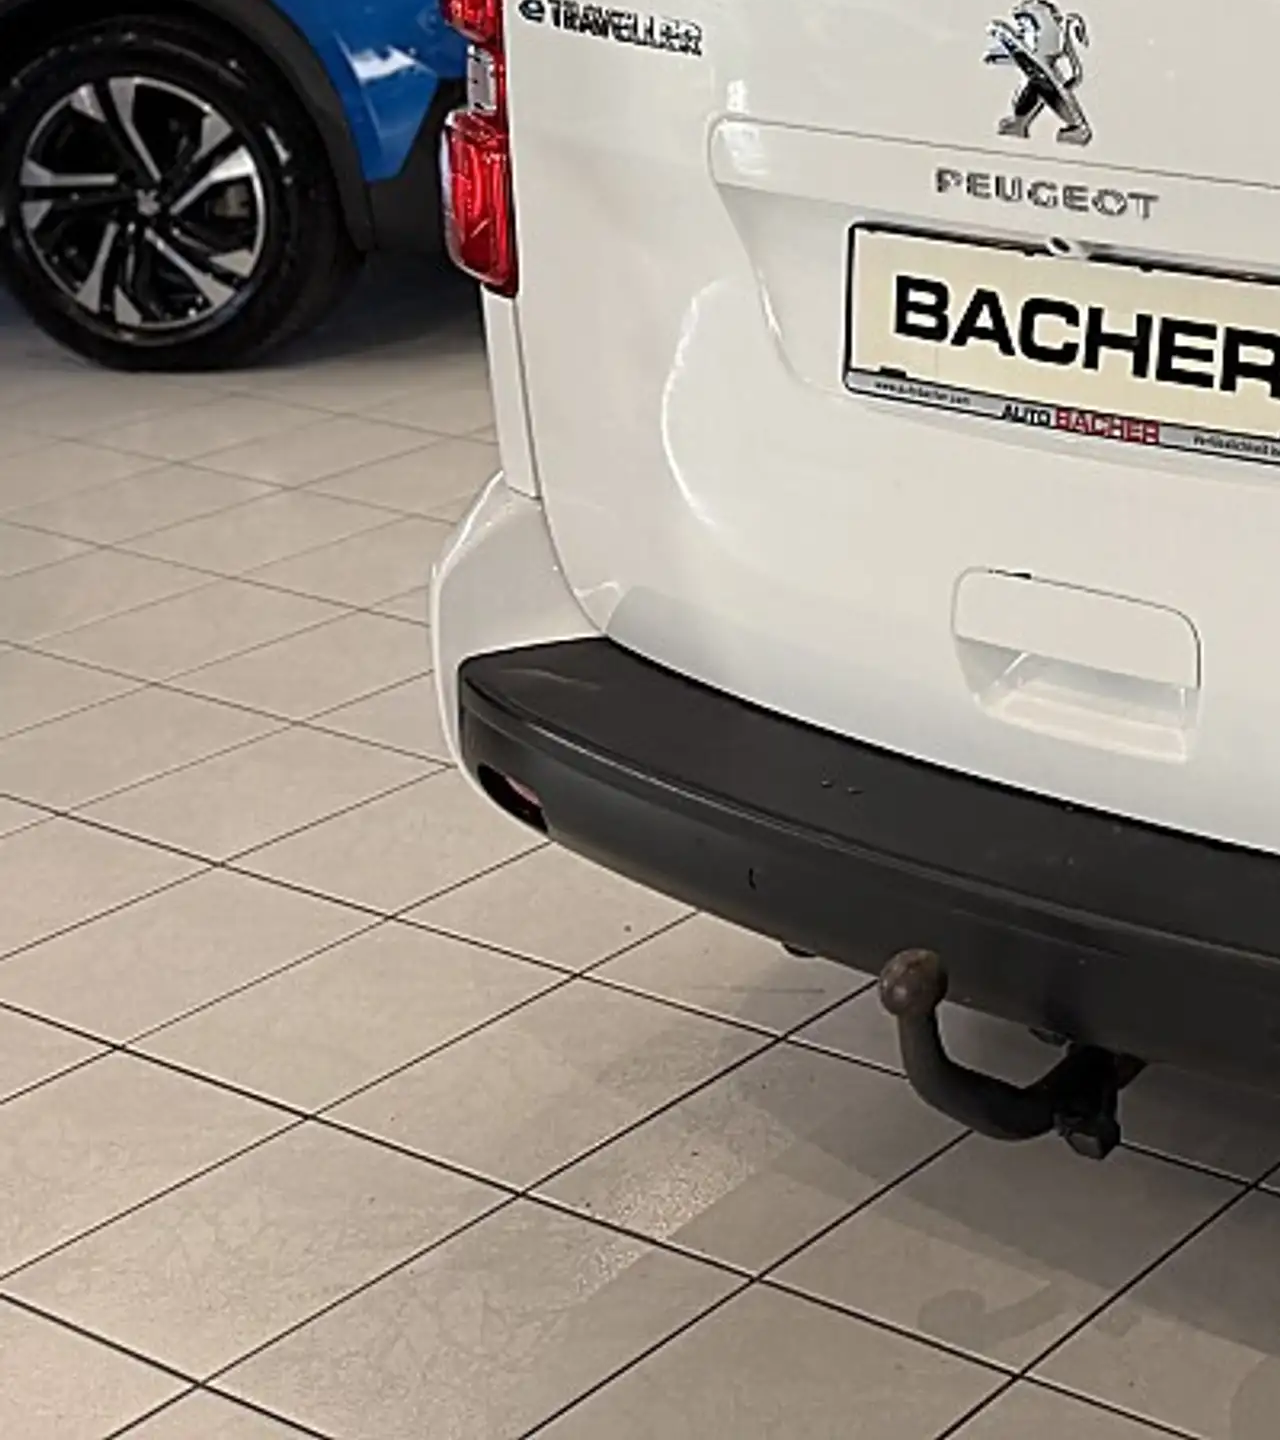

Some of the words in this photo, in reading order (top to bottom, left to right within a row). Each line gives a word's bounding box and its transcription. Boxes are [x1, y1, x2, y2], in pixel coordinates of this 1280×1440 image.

[934, 167, 1160, 220] PEUGEOT
[1002, 403, 1051, 426] AUTO
[1056, 408, 1160, 445] BACHER
